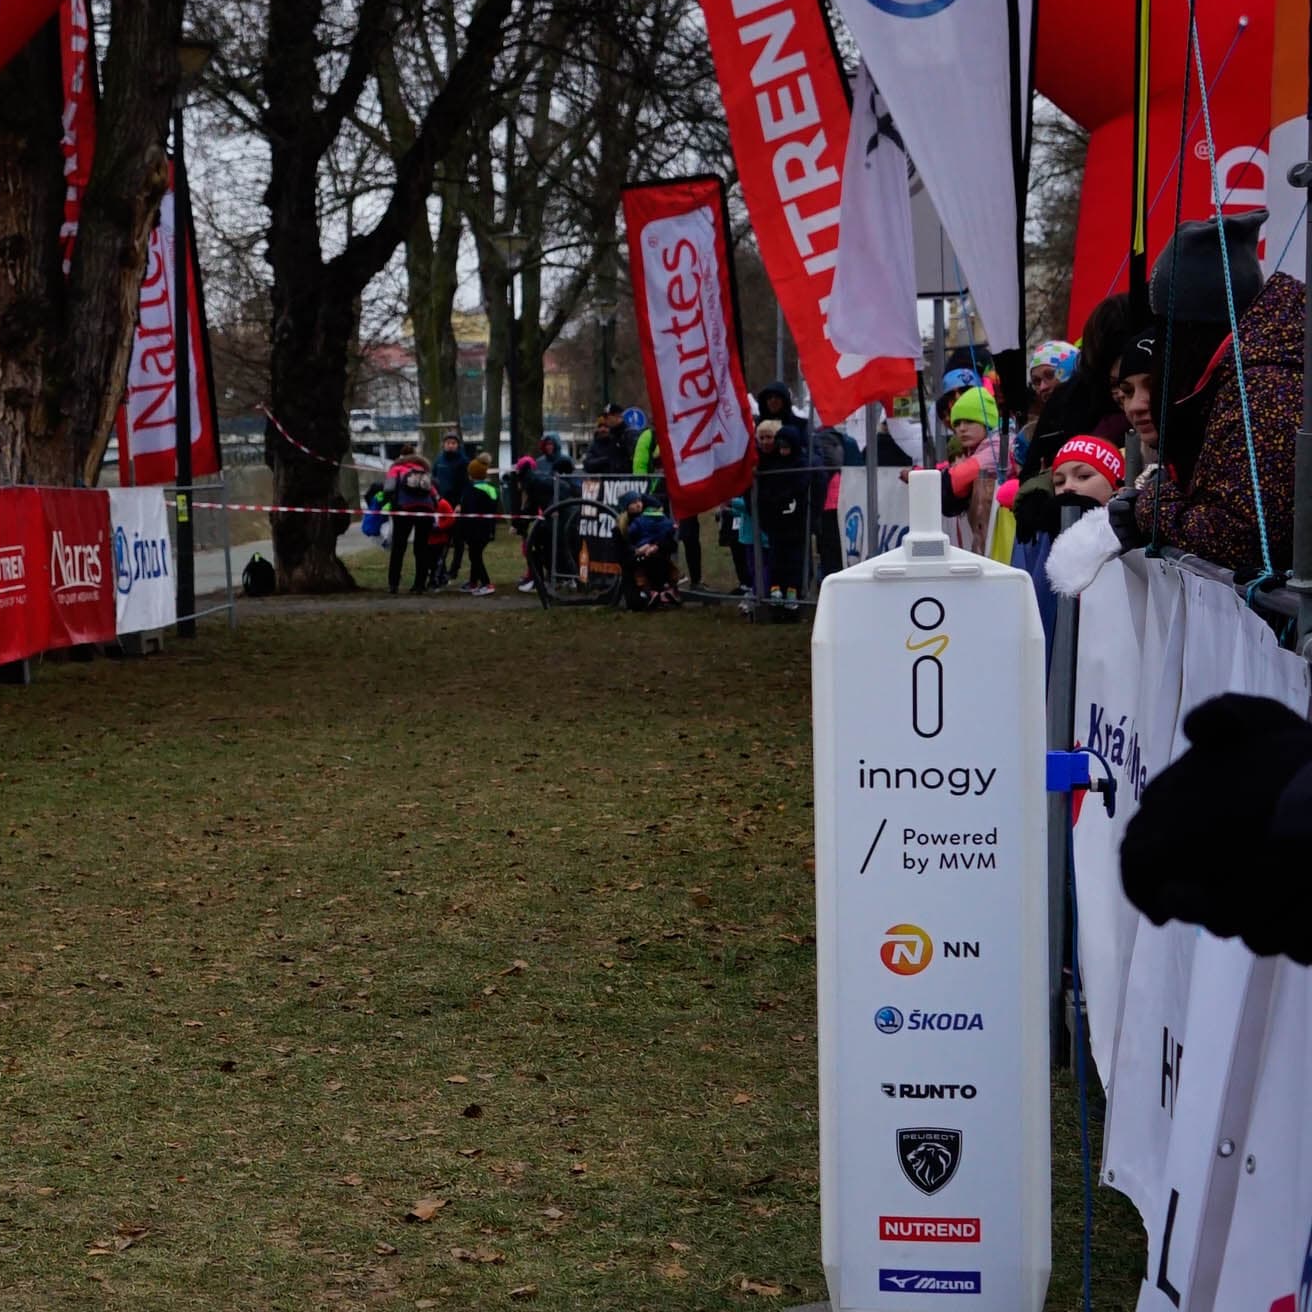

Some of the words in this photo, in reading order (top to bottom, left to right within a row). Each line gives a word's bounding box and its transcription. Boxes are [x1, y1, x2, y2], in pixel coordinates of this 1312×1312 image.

[662, 237, 725, 463] Nartes
[859, 759, 997, 796] innogy
[903, 827, 997, 845] Powered
[903, 852, 929, 874] by
[939, 853, 996, 869] MVM
[943, 941, 980, 958] NN
[908, 1009, 984, 1031] ŠKODA
[899, 1084, 977, 1099] RUNTO
[885, 1221, 975, 1237] NUTREND
